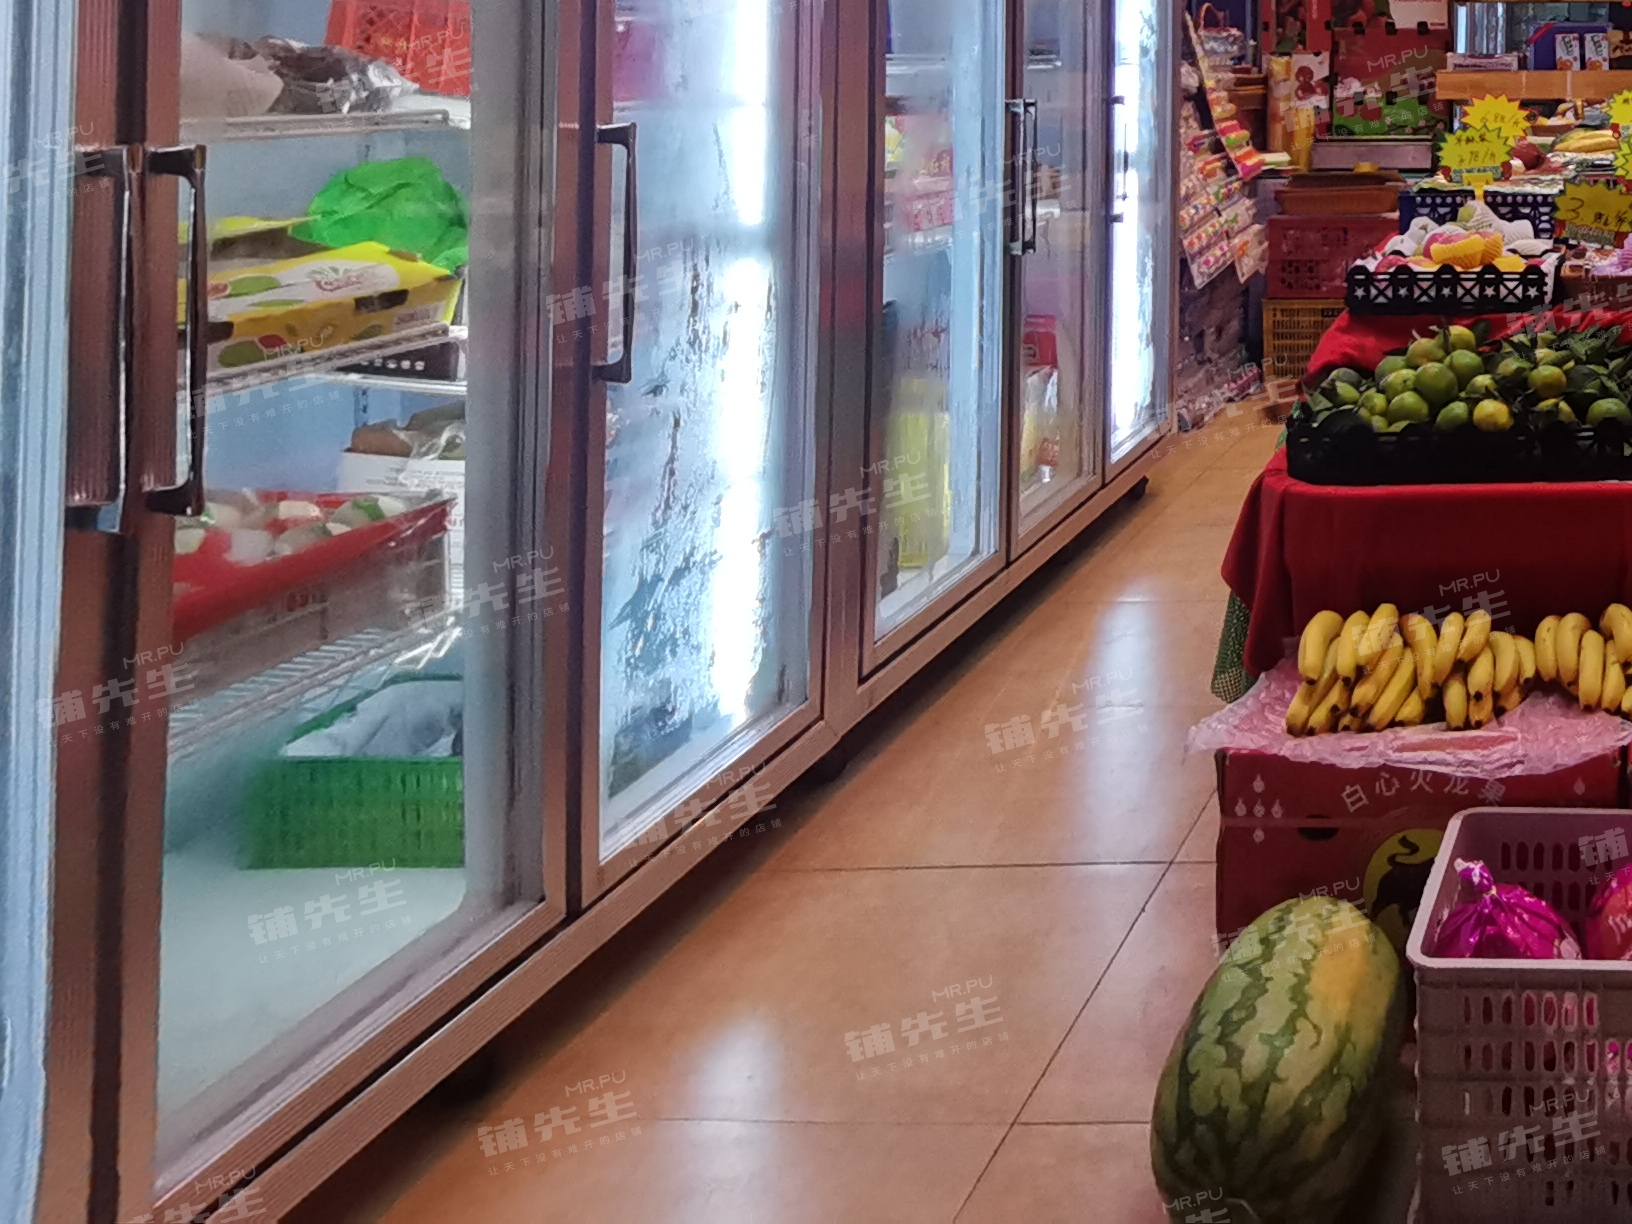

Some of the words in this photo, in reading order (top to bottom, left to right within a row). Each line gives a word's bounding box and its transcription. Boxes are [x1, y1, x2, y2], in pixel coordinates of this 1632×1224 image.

[1340, 770, 1507, 813] 白心火龙果
